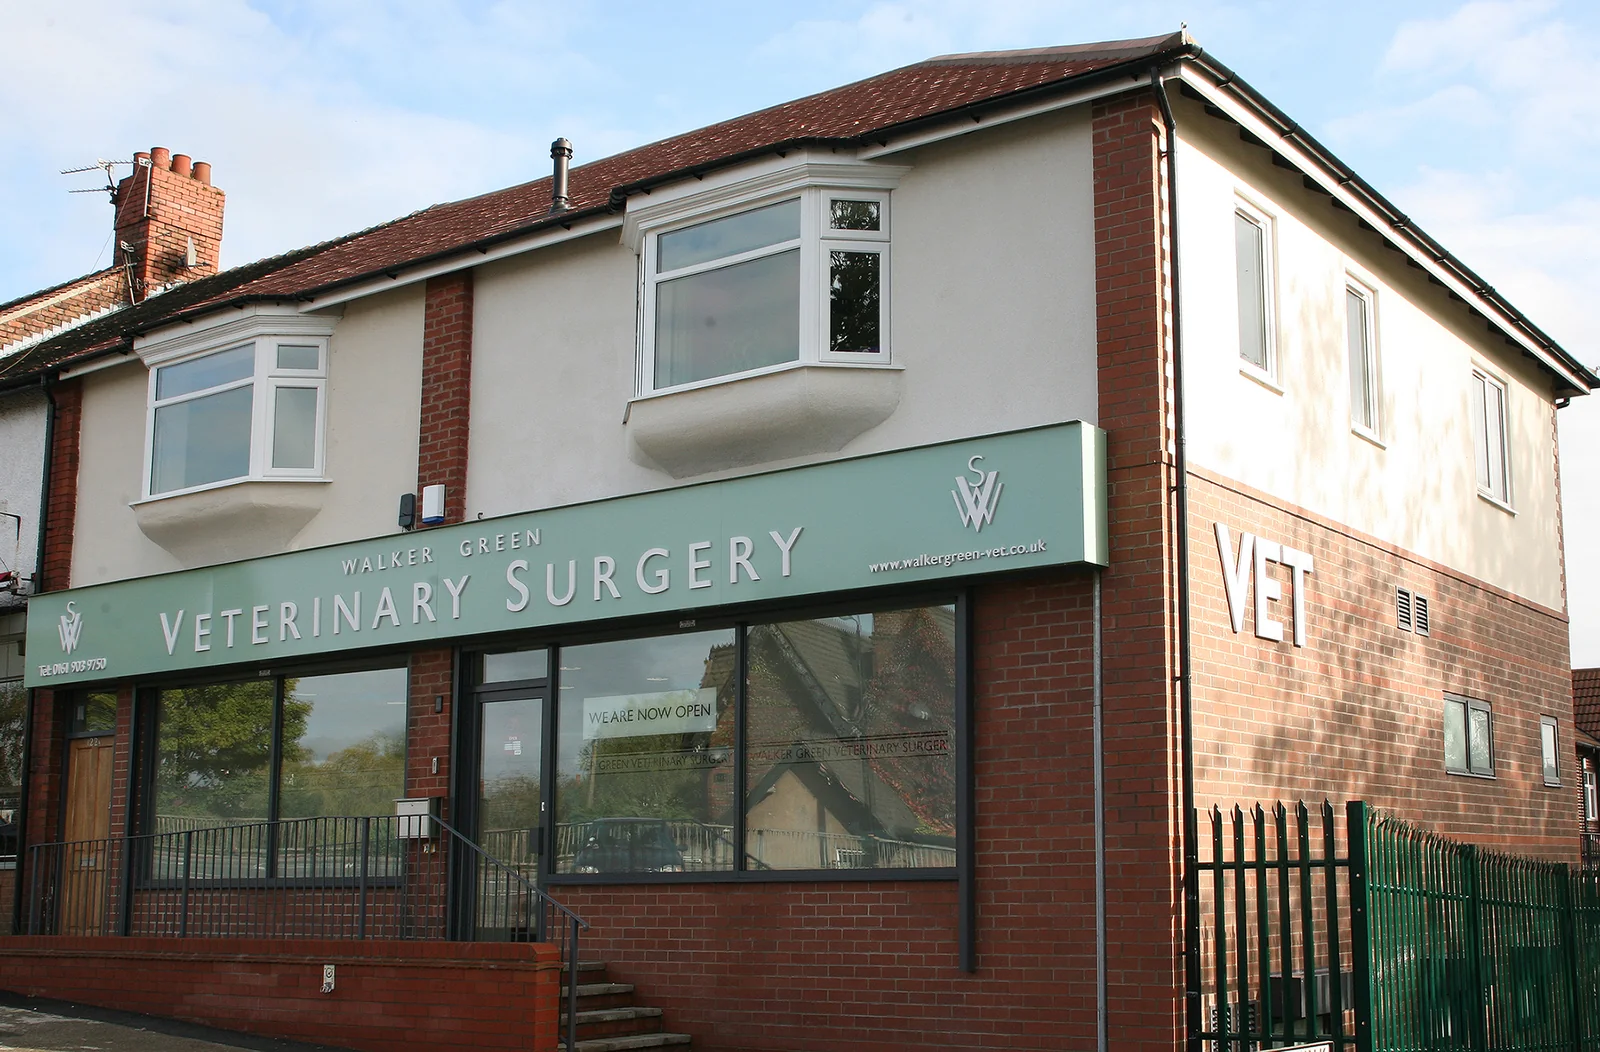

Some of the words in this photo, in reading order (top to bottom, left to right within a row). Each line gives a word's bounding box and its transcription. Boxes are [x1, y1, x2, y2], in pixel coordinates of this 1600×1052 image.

[341, 546, 434, 576] WALKER
[459, 528, 542, 557] GREEN
[868, 539, 1048, 573] www.walkergreen-vet.co.uk
[159, 574, 472, 656] VETERINARY
[505, 526, 805, 613] SURGERY
[1213, 521, 1314, 648] VET
[52, 662, 69, 676] 0161
[70, 659, 86, 673] 903
[86, 656, 107, 671] 9750
[589, 711, 609, 724] WE
[610, 709, 634, 723] ARE
[637, 706, 672, 721] NOW
[675, 703, 711, 718] OPEN
[795, 745, 831, 759] GREEN
[833, 741, 901, 757] VETERINARY
[599, 757, 629, 771] GREEN
